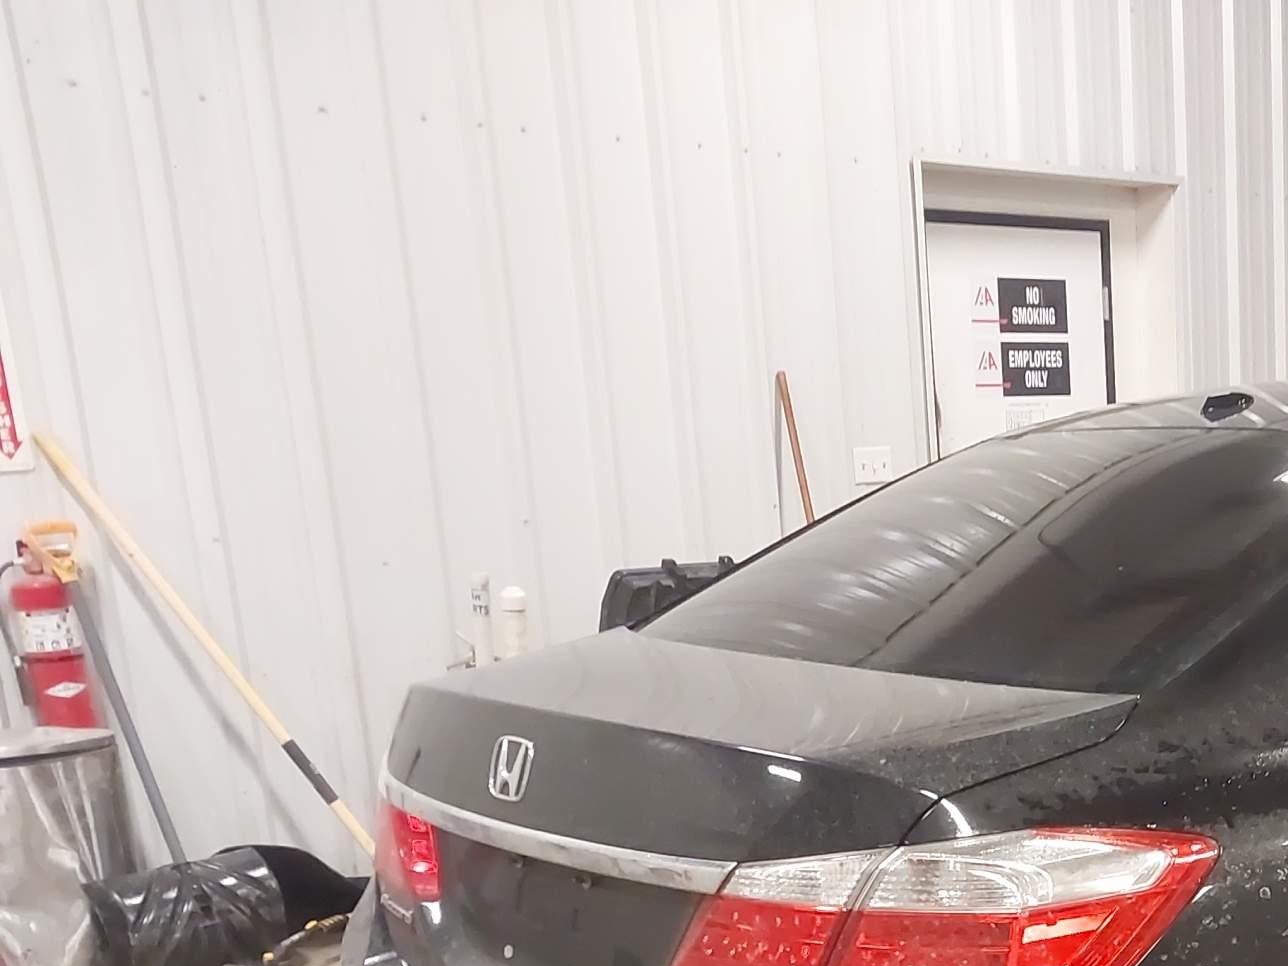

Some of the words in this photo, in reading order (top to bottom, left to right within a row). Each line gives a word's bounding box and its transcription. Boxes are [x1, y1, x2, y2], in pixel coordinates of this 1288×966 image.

[1025, 286, 1039, 305] NO
[1011, 306, 1056, 325] SMOKING
[1008, 350, 1062, 368] EMPLOYEES
[1024, 370, 1049, 388] ONLY
